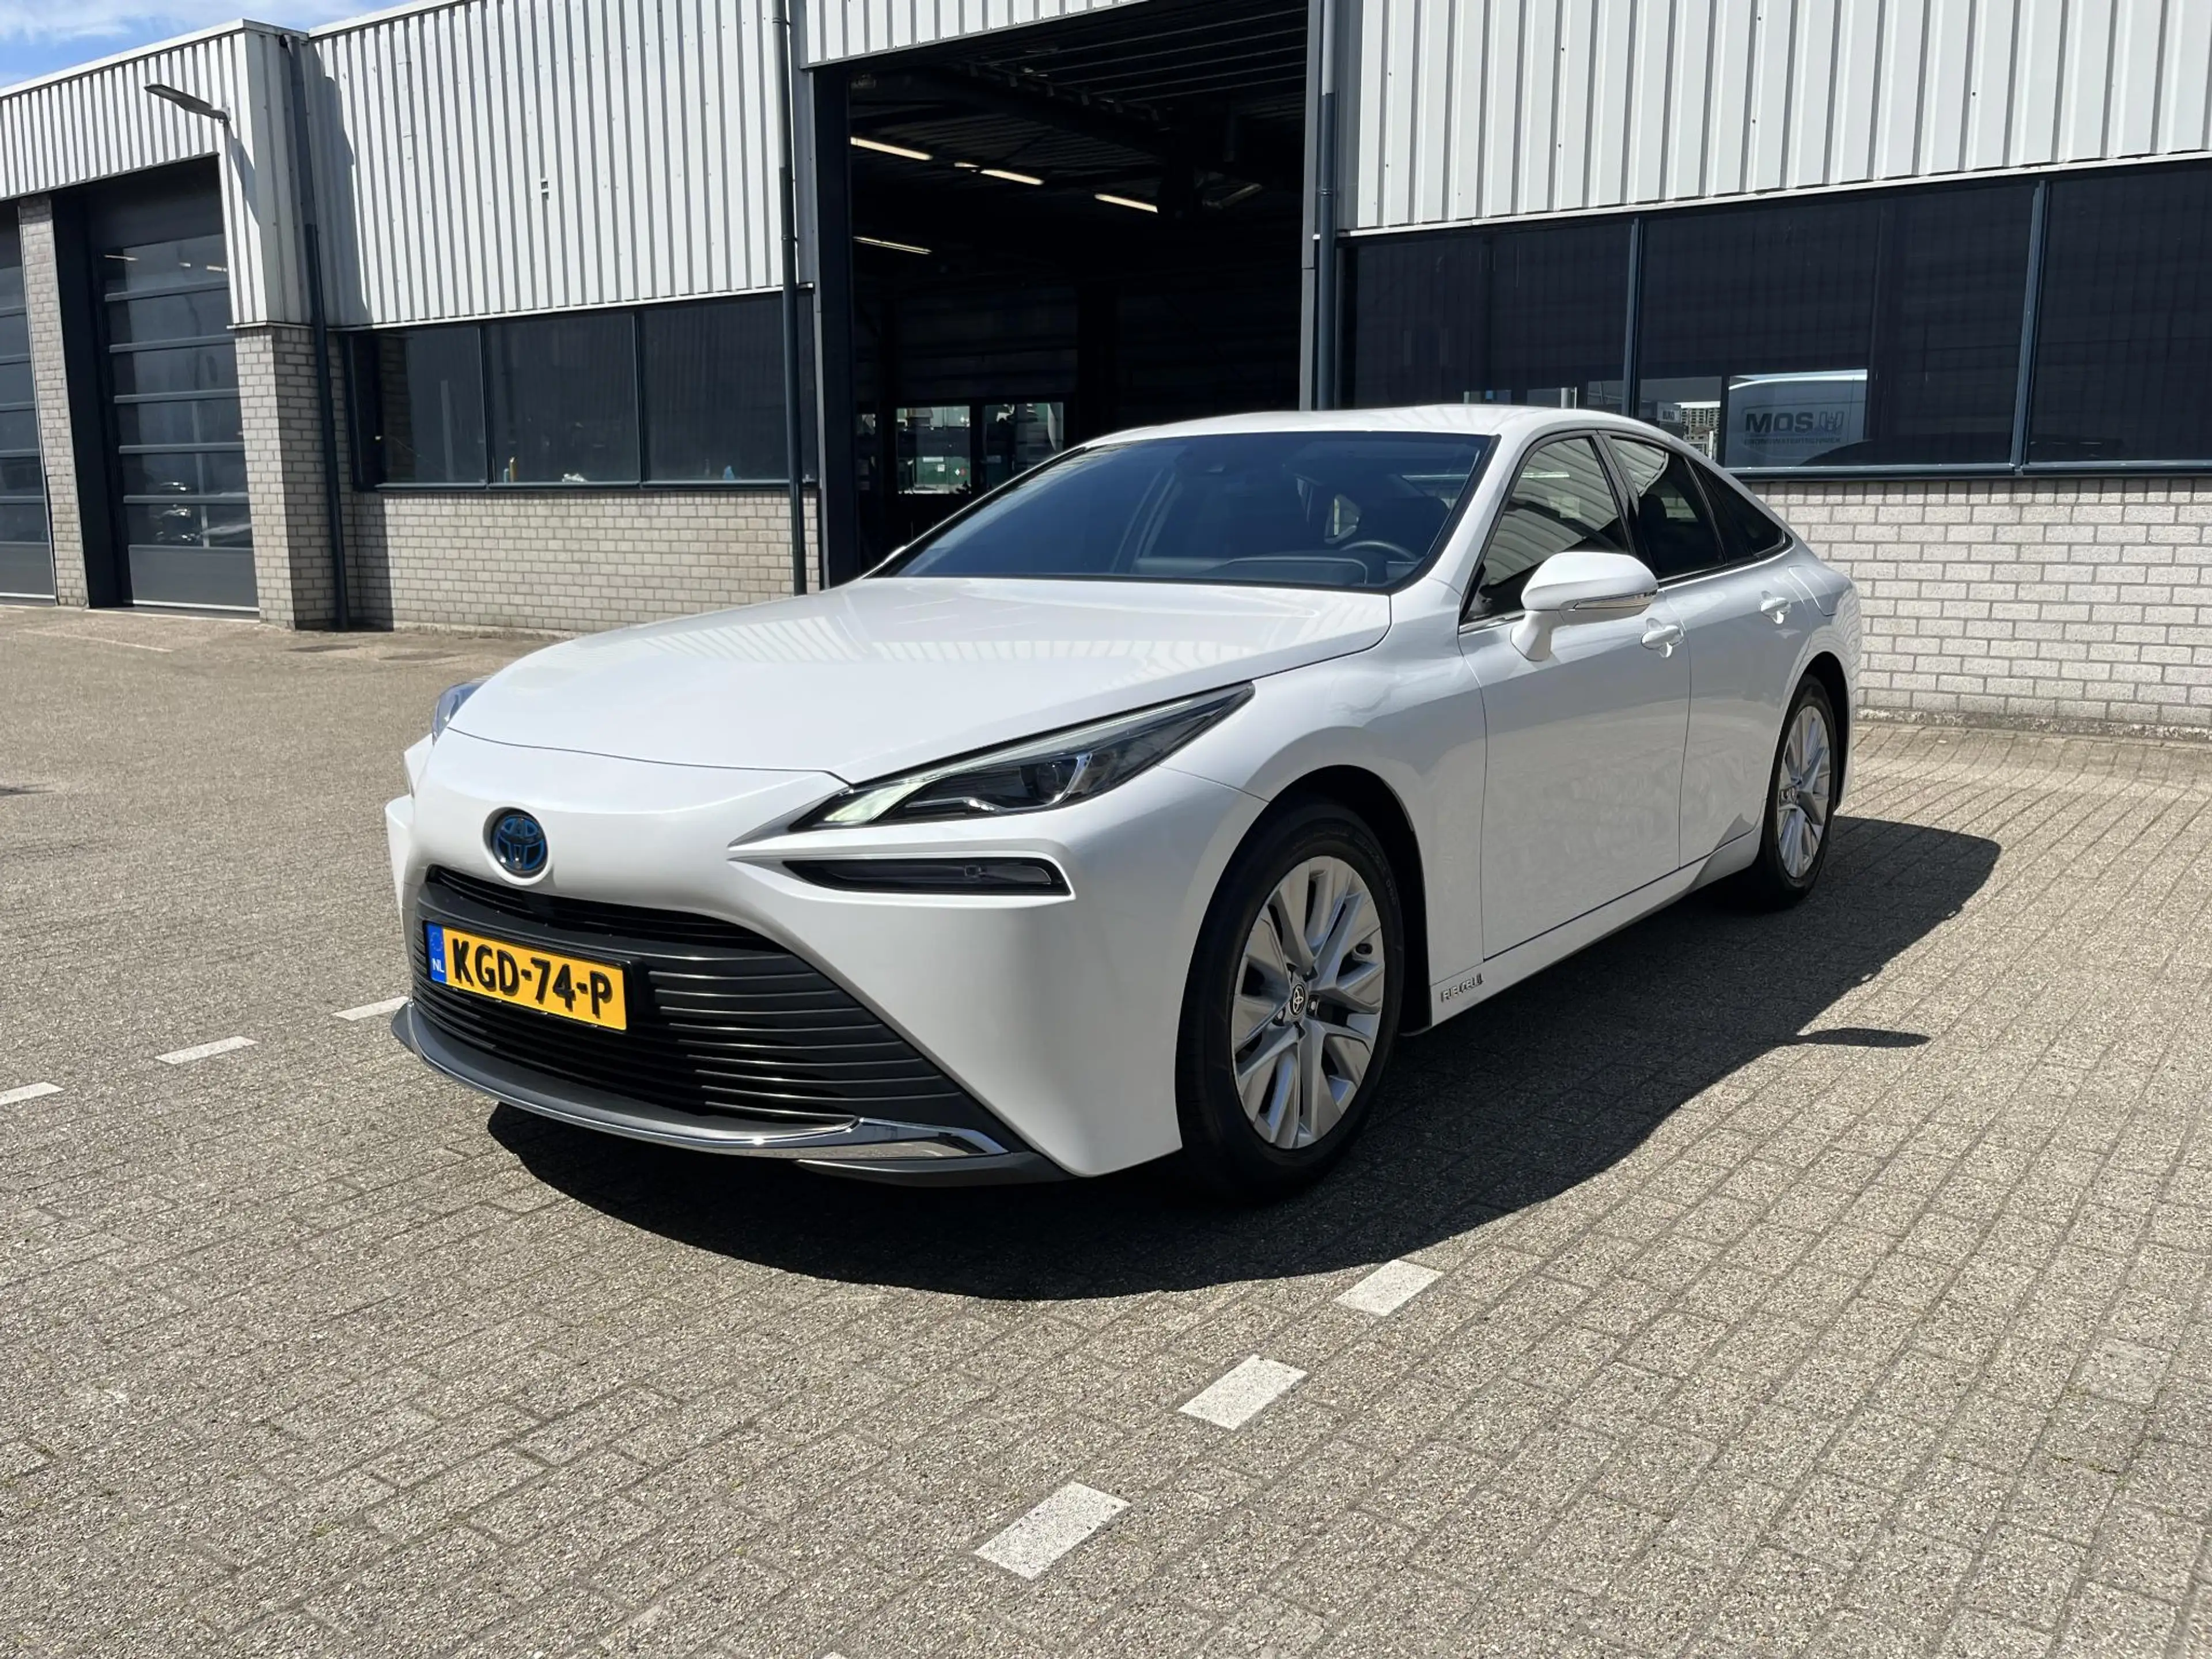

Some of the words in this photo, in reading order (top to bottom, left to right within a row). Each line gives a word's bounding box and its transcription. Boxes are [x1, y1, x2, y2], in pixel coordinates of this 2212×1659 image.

[1745, 411, 1813, 434] MOS
[432, 959, 444, 973] NL
[452, 938, 613, 1019] KGD-74-P
